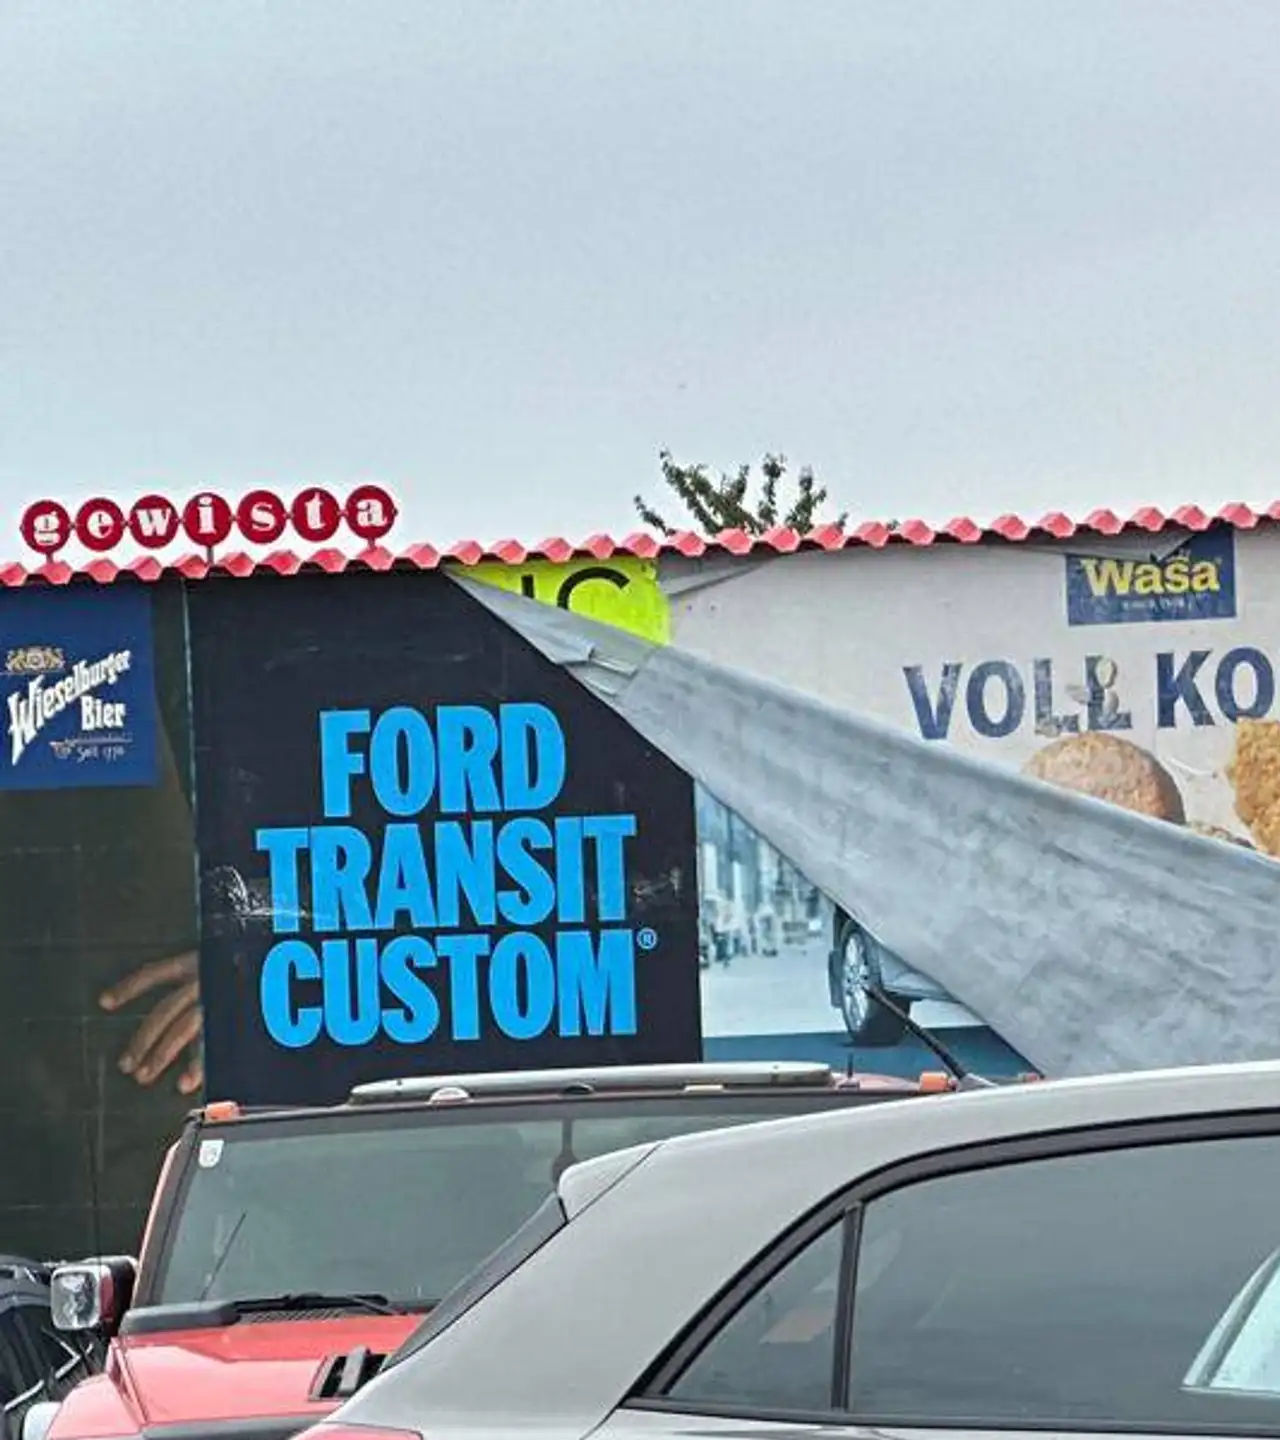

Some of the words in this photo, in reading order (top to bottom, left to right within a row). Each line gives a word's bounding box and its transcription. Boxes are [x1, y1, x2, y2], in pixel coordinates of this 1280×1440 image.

[32, 491, 388, 546] gewista
[1079, 552, 1221, 597] Wasa
[7, 649, 132, 767] Wieselburger
[80, 694, 127, 732] Bier
[902, 654, 1133, 741] VOLL
[318, 702, 566, 818] FORD
[255, 814, 637, 934] TRANSIT
